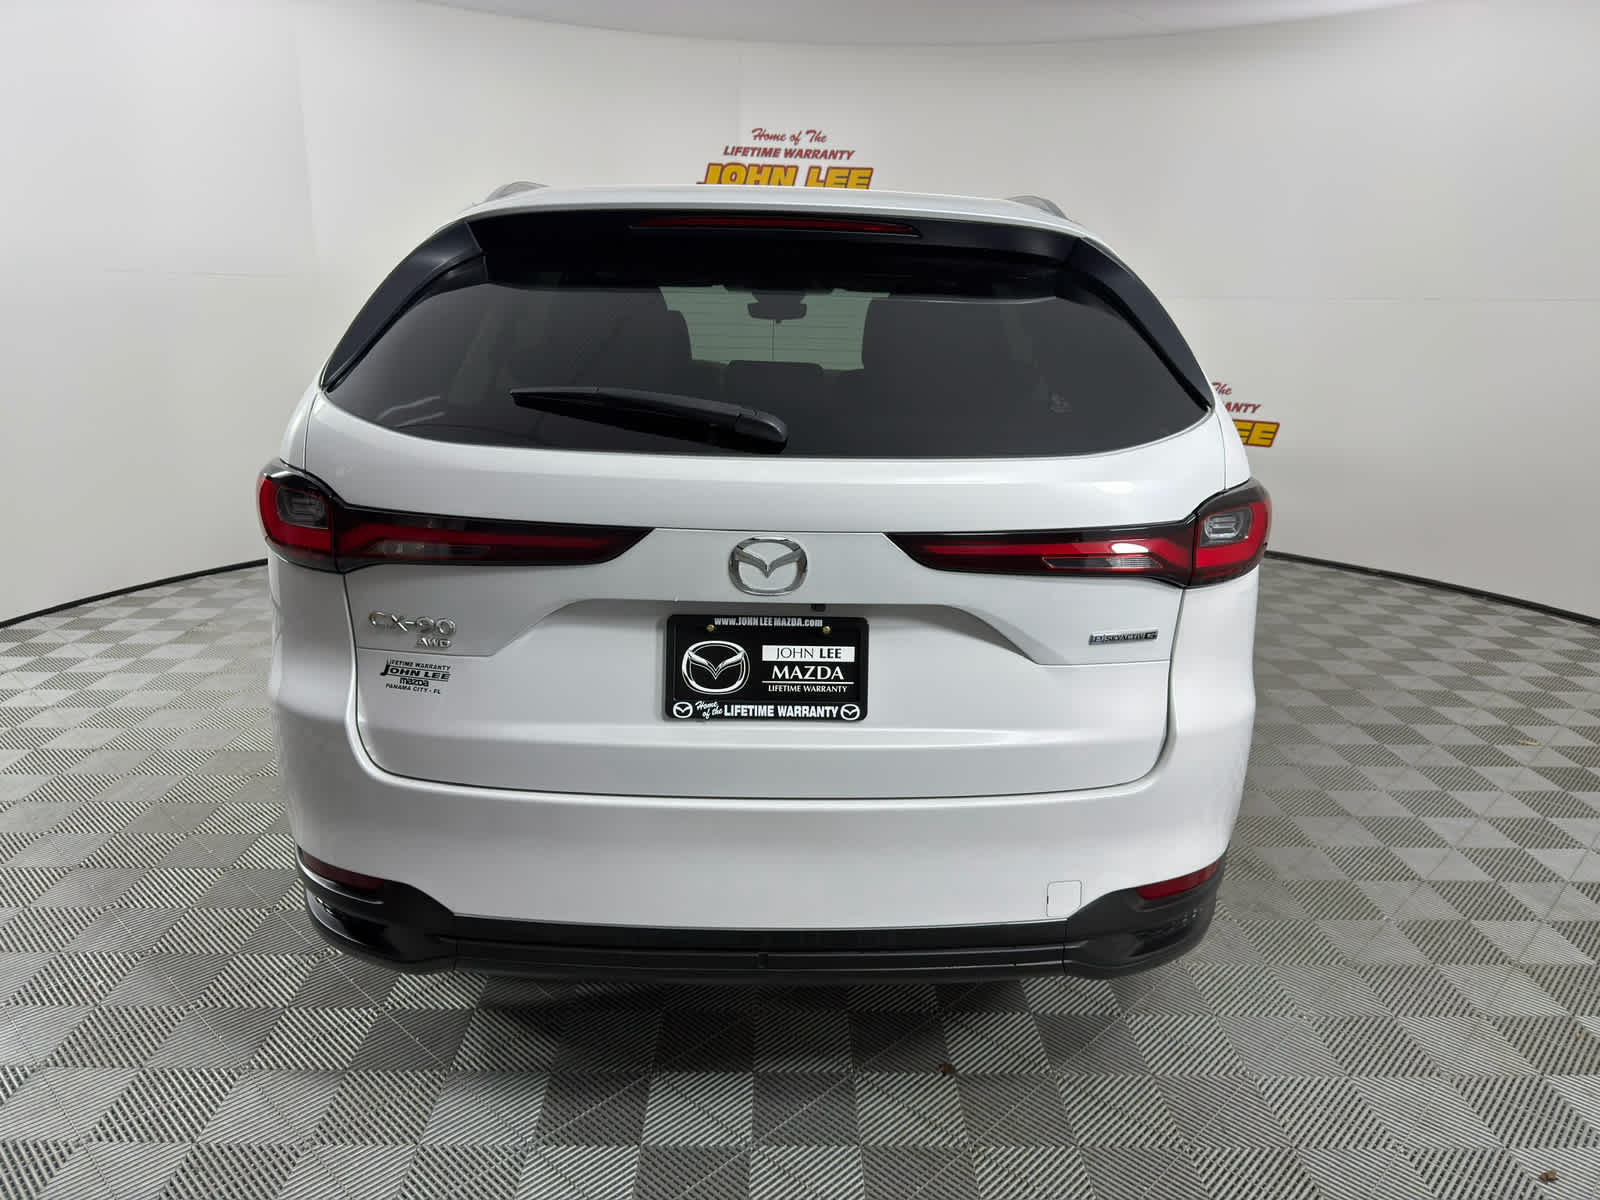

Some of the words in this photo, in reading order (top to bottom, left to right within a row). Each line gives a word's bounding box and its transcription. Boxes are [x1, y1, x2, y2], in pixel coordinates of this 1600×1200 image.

[751, 127, 786, 142] Home
[789, 131, 801, 145] of
[805, 129, 827, 143] The
[723, 146, 781, 158] LIFETIME
[783, 148, 855, 160] WARRANTY
[696, 162, 799, 186] JOHN
[804, 165, 874, 190] LEE
[776, 647, 815, 660] JOHN
[819, 648, 842, 659] LEE
[380, 664, 420, 677] JOHN
[423, 671, 451, 680] LEE
[415, 661, 451, 670] WARRANTY
[771, 665, 845, 681] MAZDA
[385, 683, 412, 692] PANAMA
[399, 677, 429, 687] mazda
[768, 684, 801, 692] LIFETIME
[803, 685, 848, 693] WARRANTY
[694, 700, 719, 711] Home
[724, 704, 775, 718] LIFETIME
[777, 705, 839, 719] WARRANTY
[702, 710, 711, 720] of
[712, 706, 723, 716] the
